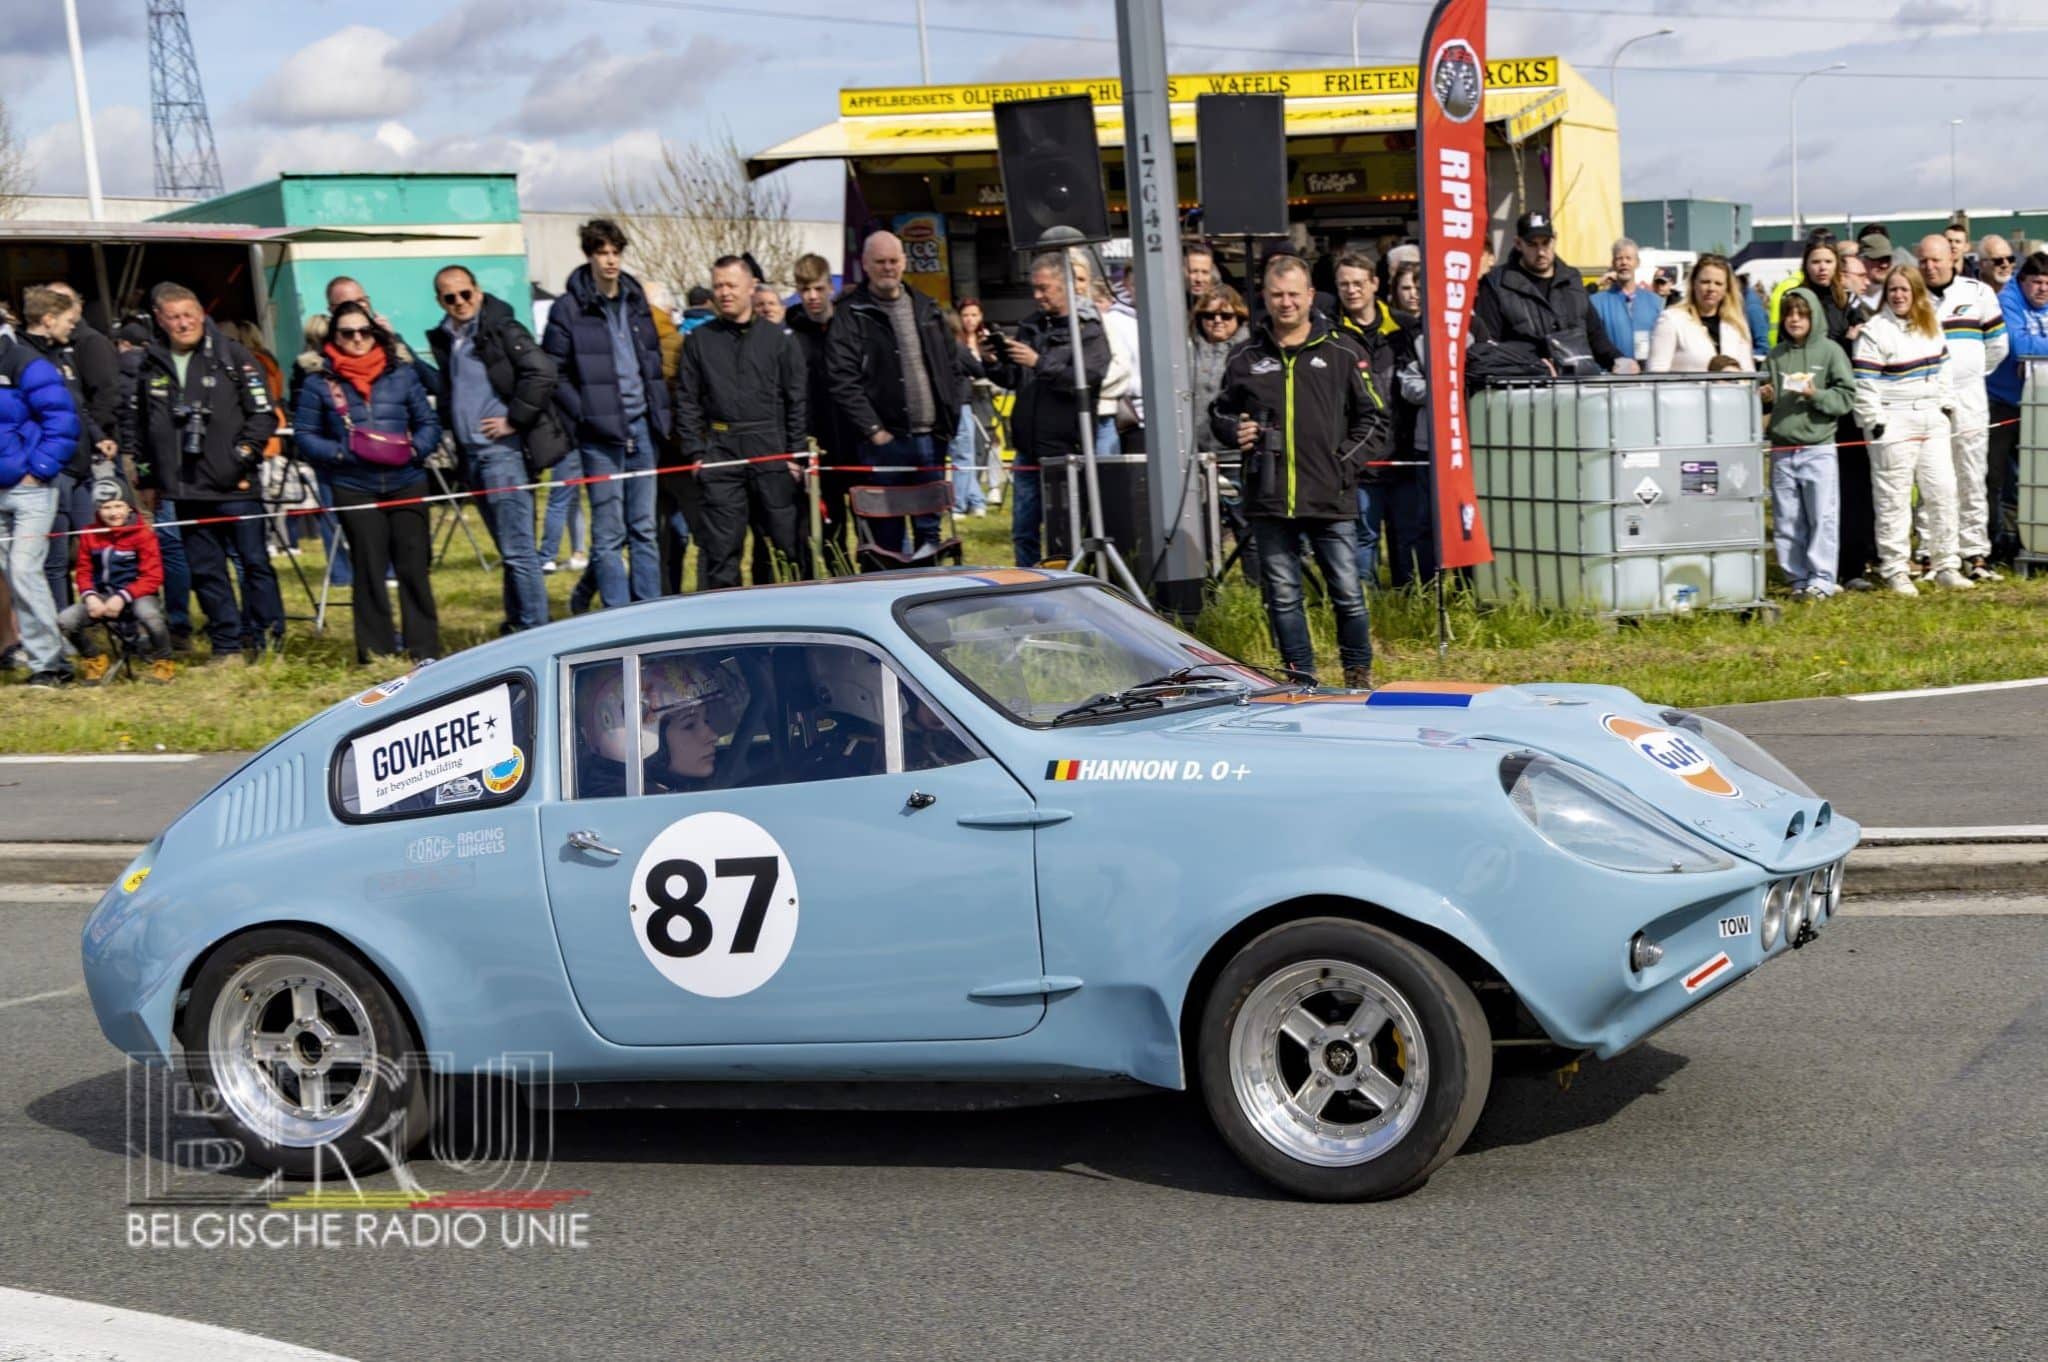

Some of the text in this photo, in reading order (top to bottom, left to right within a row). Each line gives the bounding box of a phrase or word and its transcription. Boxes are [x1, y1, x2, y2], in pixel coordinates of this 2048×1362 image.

[1208, 75, 1290, 95] WAFELS
[1324, 71, 1416, 92] FRIETEN
[1484, 62, 1549, 84] ACKS
[1439, 148, 1473, 239] RPR
[372, 710, 482, 782] GOVAERE
[1641, 737, 1704, 770] Gulf
[376, 757, 464, 799] far beyond building
[1078, 759, 1178, 781] HANNON
[1182, 760, 1204, 781] D.
[408, 838, 449, 861] FORCE
[457, 827, 505, 845] RACING
[457, 840, 506, 858] WHEELS
[645, 855, 779, 958] 87
[1720, 916, 1749, 936] TOW
